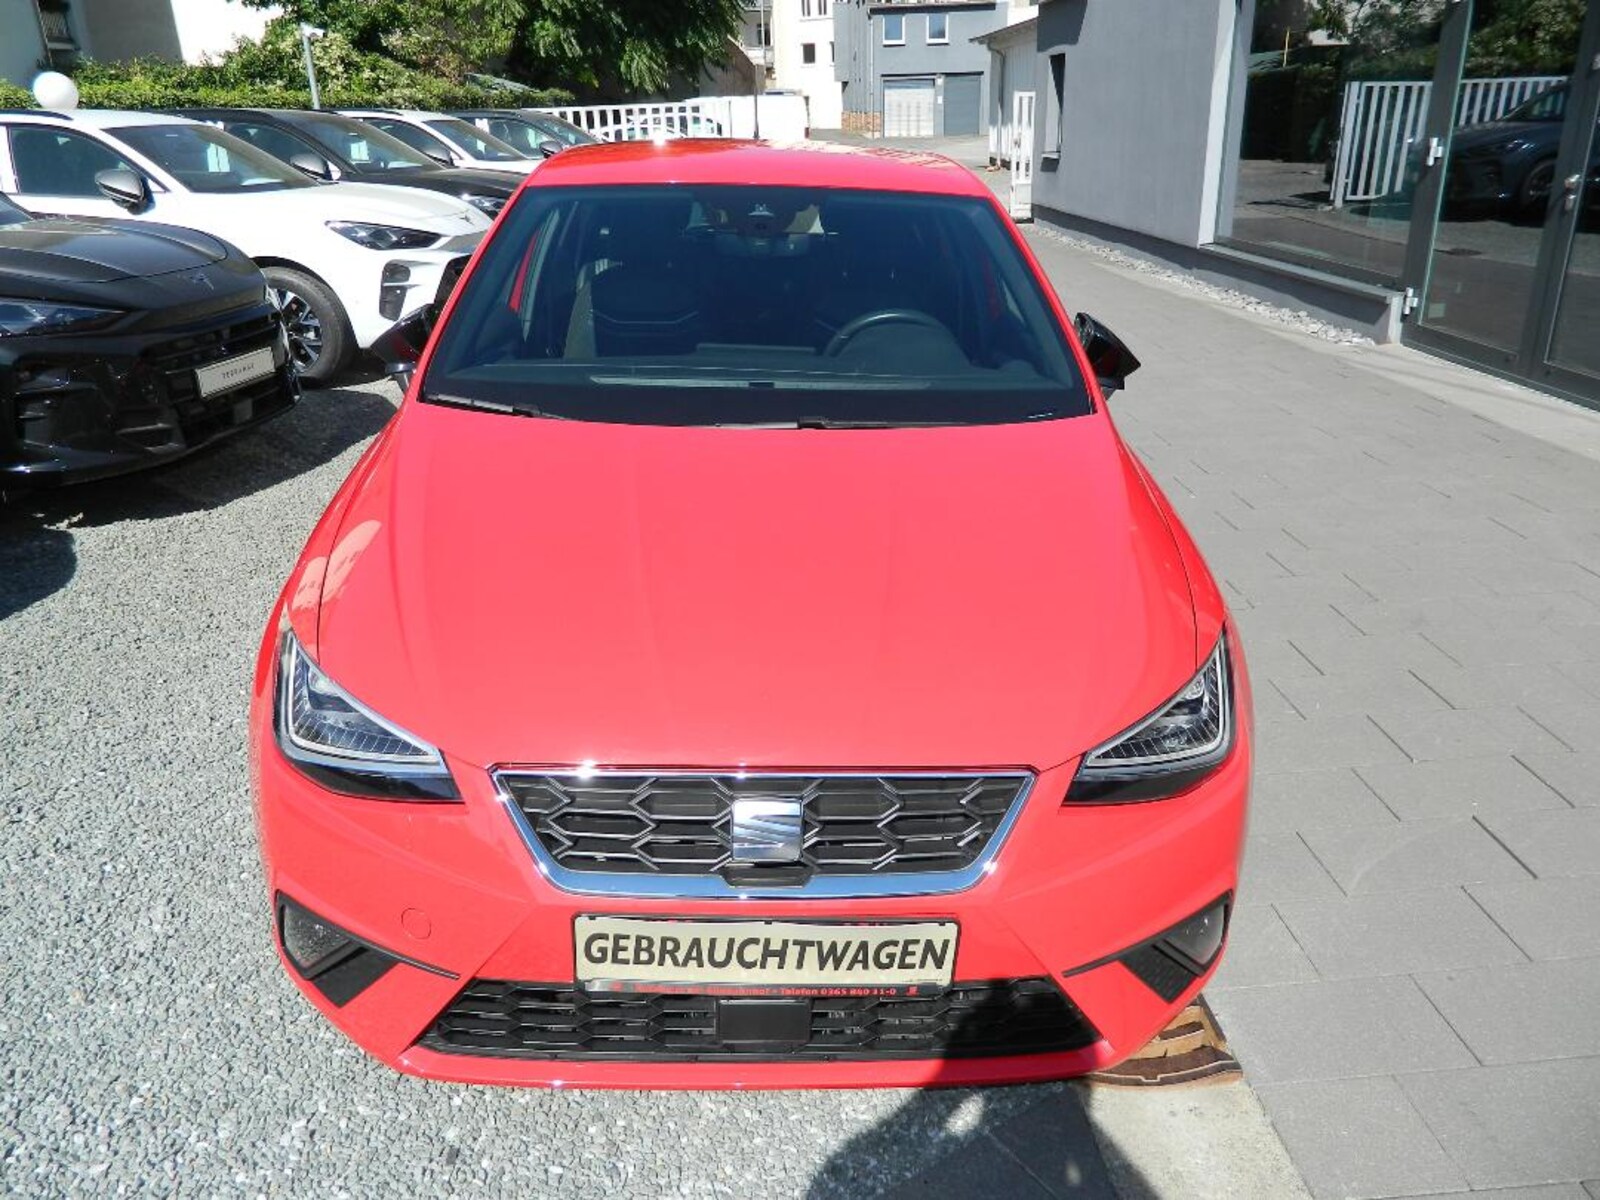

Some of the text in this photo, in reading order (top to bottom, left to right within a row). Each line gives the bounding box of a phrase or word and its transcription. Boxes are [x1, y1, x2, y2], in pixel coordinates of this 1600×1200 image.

[584, 932, 950, 971] GEBRAUCHTWAGEN
[780, 986, 818, 996] Telefon
[820, 986, 848, 997] 0365
